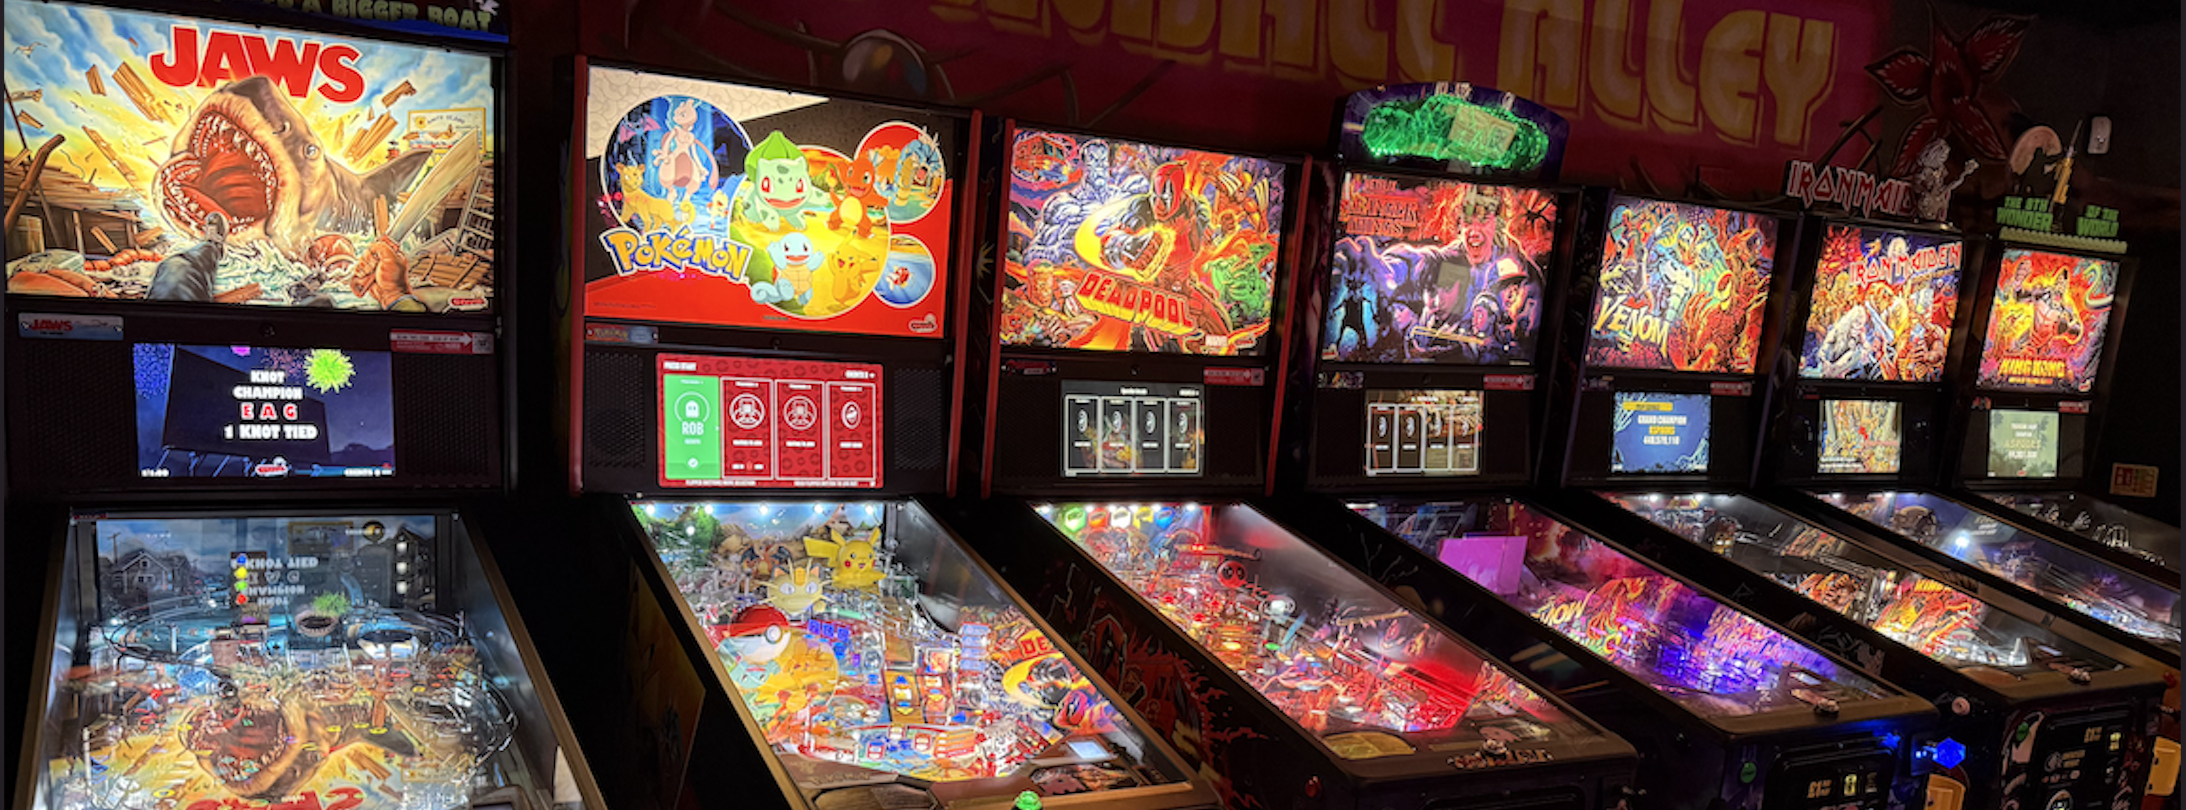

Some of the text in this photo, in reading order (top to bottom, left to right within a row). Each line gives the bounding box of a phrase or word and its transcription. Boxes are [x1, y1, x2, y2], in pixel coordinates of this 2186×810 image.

[332, 0, 419, 21] BIGGER
[427, 6, 492, 32] BOAT
[149, 26, 365, 103] JAWS
[1495, 0, 1838, 148] ALLEY
[1786, 160, 1857, 211] IRON
[1997, 206, 2054, 233] WONDER
[1849, 256, 1894, 290] IRON
[1893, 241, 1963, 281] MAIDEN
[1079, 272, 1194, 329] DEADPOOL
[1594, 296, 1670, 359] VENOM
[232, 385, 304, 400] CHAMPION
[250, 369, 285, 384] KNOT
[223, 424, 319, 440] 1 KNOT TIED
[681, 421, 704, 436] ROB
[1020, 635, 1053, 659] DE
